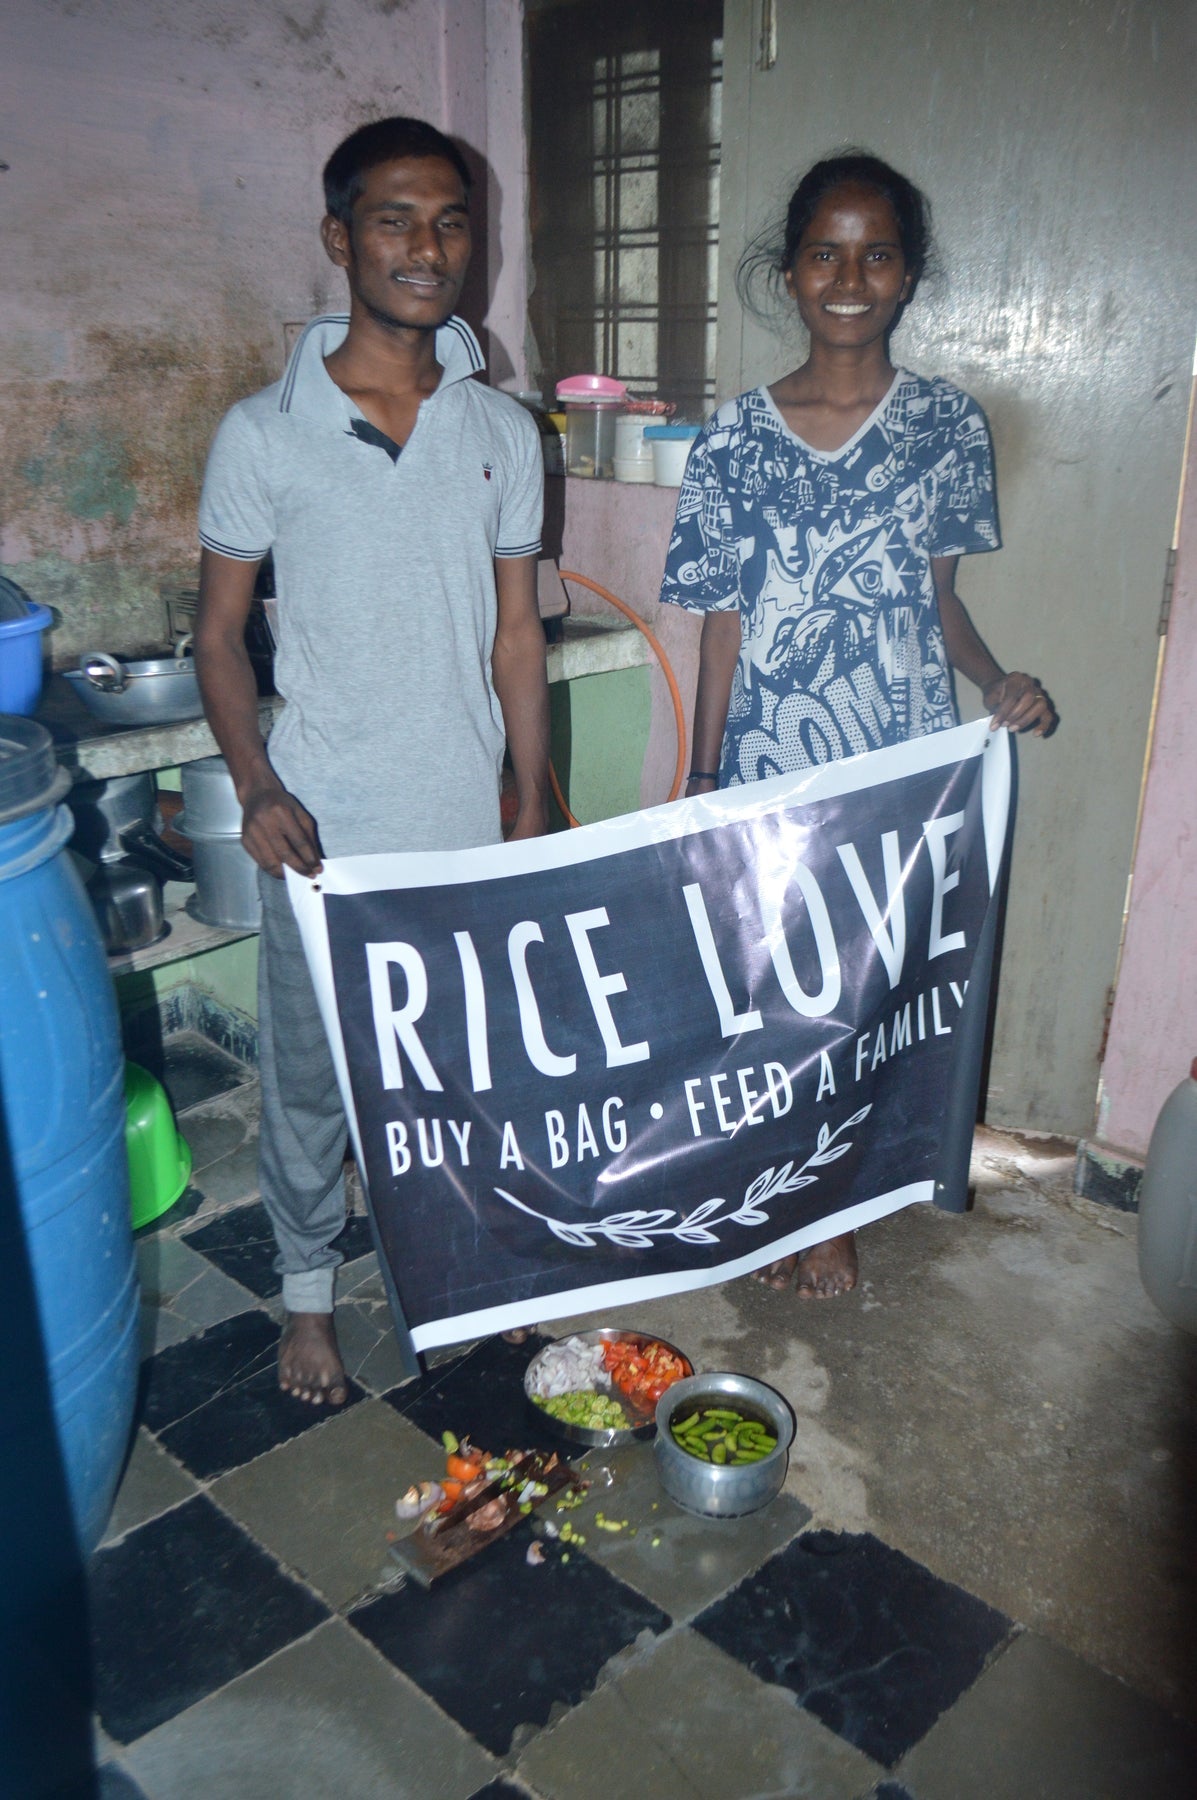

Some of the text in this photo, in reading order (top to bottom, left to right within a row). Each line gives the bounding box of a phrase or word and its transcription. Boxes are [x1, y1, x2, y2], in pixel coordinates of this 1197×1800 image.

[365, 811, 966, 1092] RICE LOVE
[386, 1118, 472, 1177] BUY
[499, 1121, 526, 1171] A
[545, 1096, 628, 1169] BAG
[684, 1061, 793, 1137] FEED
[816, 1050, 837, 1102] A
